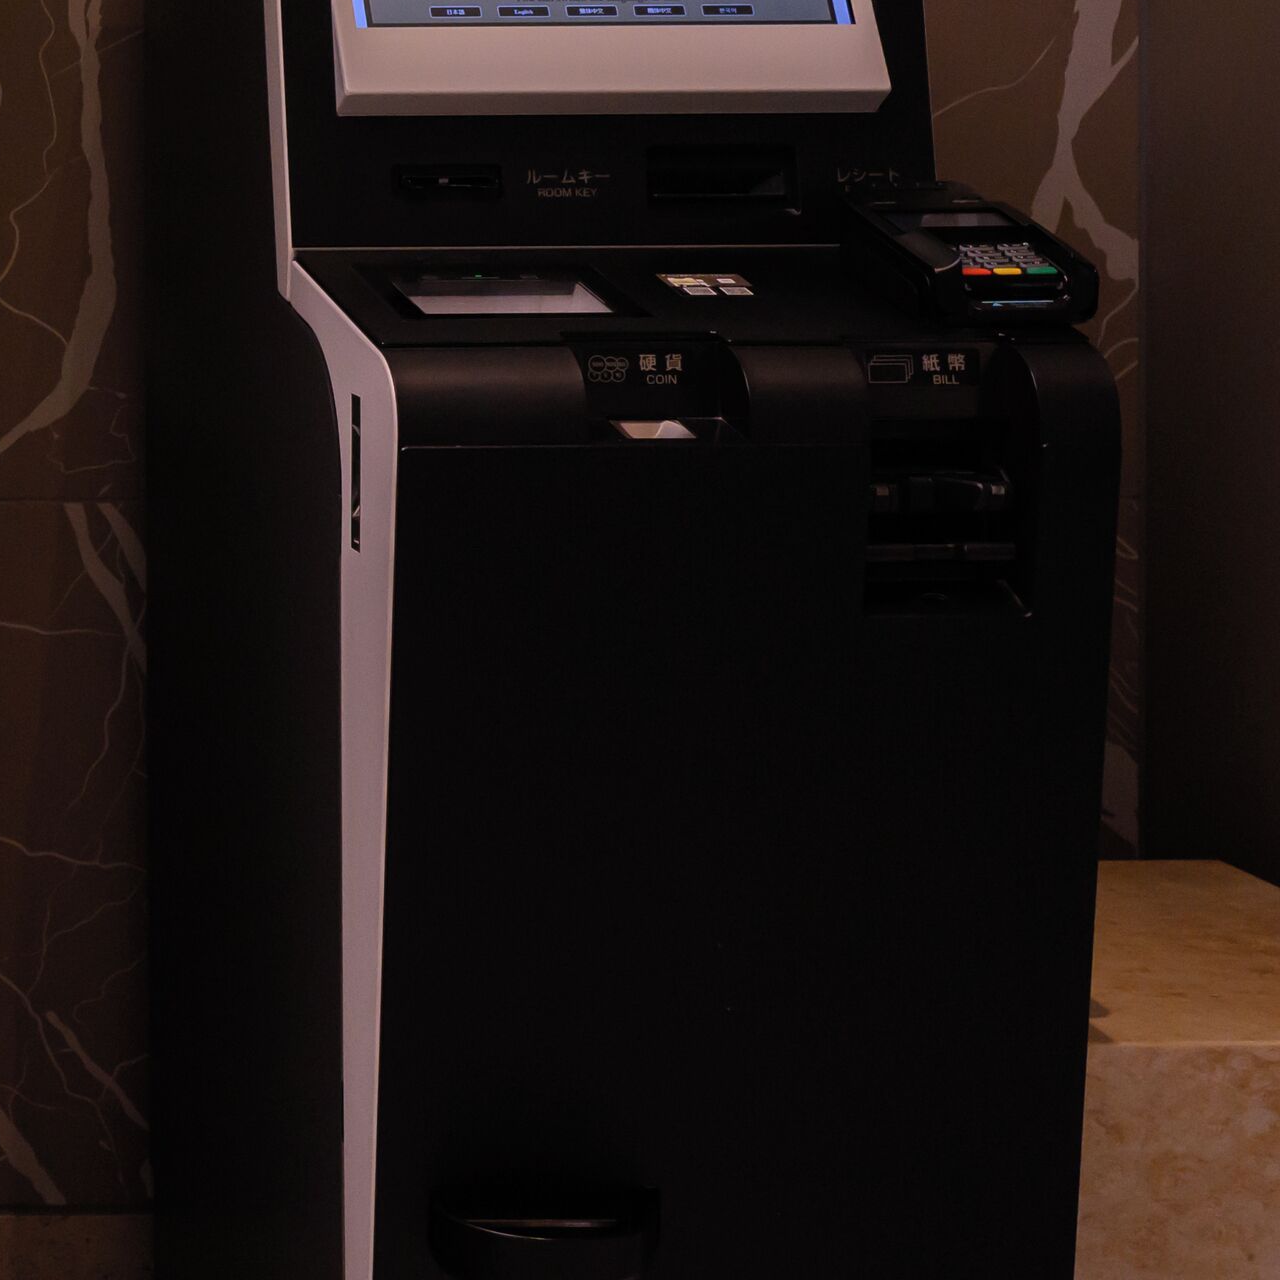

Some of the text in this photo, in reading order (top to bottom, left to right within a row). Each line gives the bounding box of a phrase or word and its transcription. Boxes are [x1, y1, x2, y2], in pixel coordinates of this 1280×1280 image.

[526, 168, 611, 185] ルームキー
[537, 187, 598, 198] ROOM KEY
[646, 374, 678, 385] COIN
[932, 374, 960, 385] BILL
